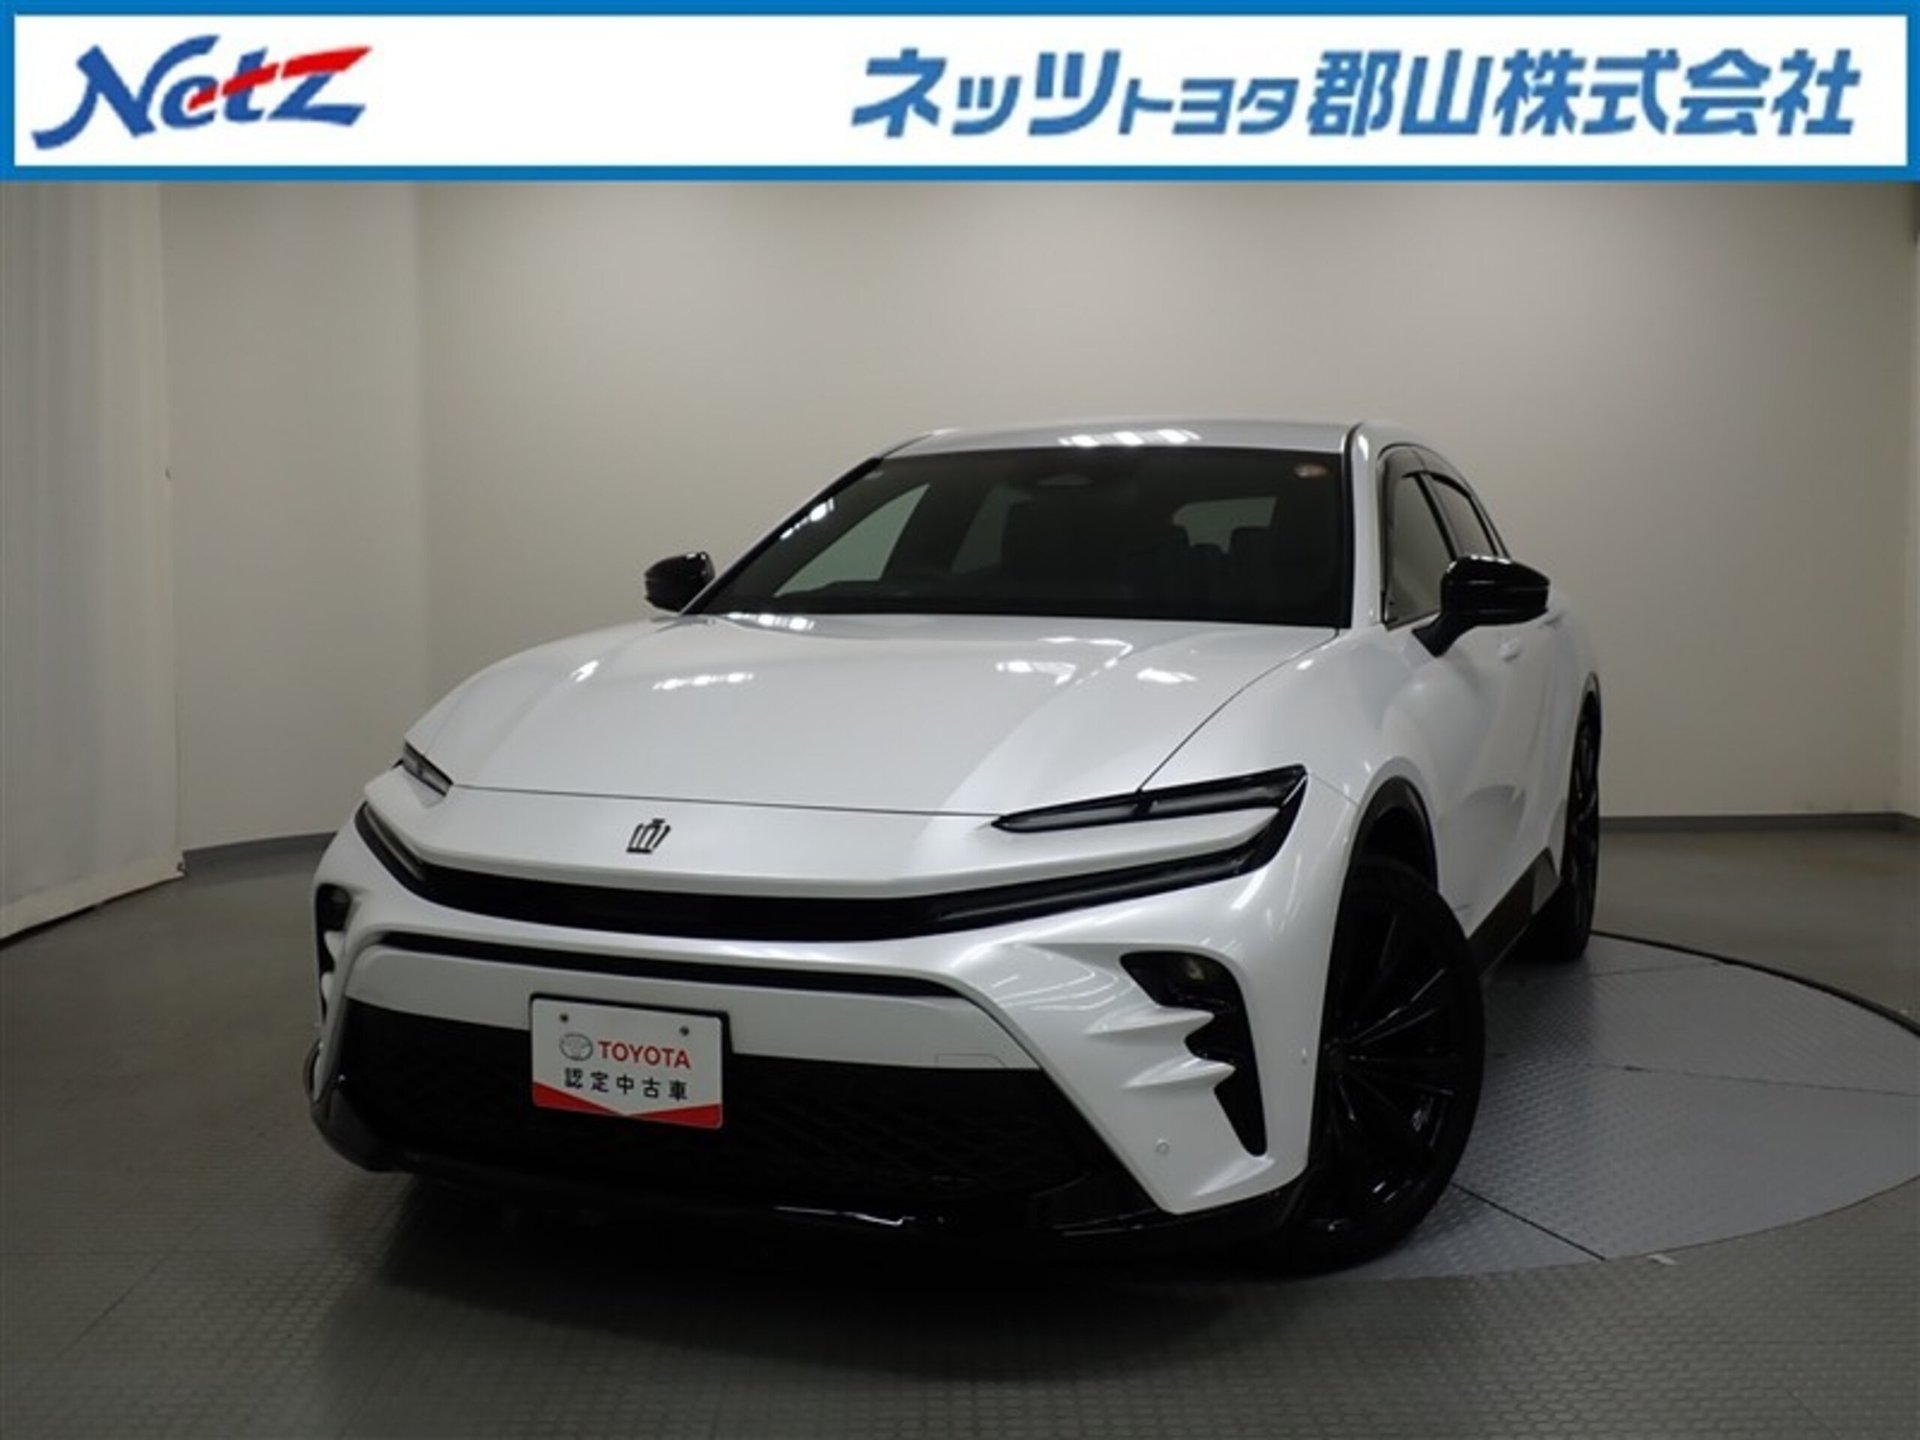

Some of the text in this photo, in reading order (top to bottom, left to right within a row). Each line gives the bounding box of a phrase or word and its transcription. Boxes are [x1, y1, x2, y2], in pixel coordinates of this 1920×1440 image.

[599, 1040, 691, 1070] TOYOTA
[564, 1067, 688, 1102] 認定中古車
